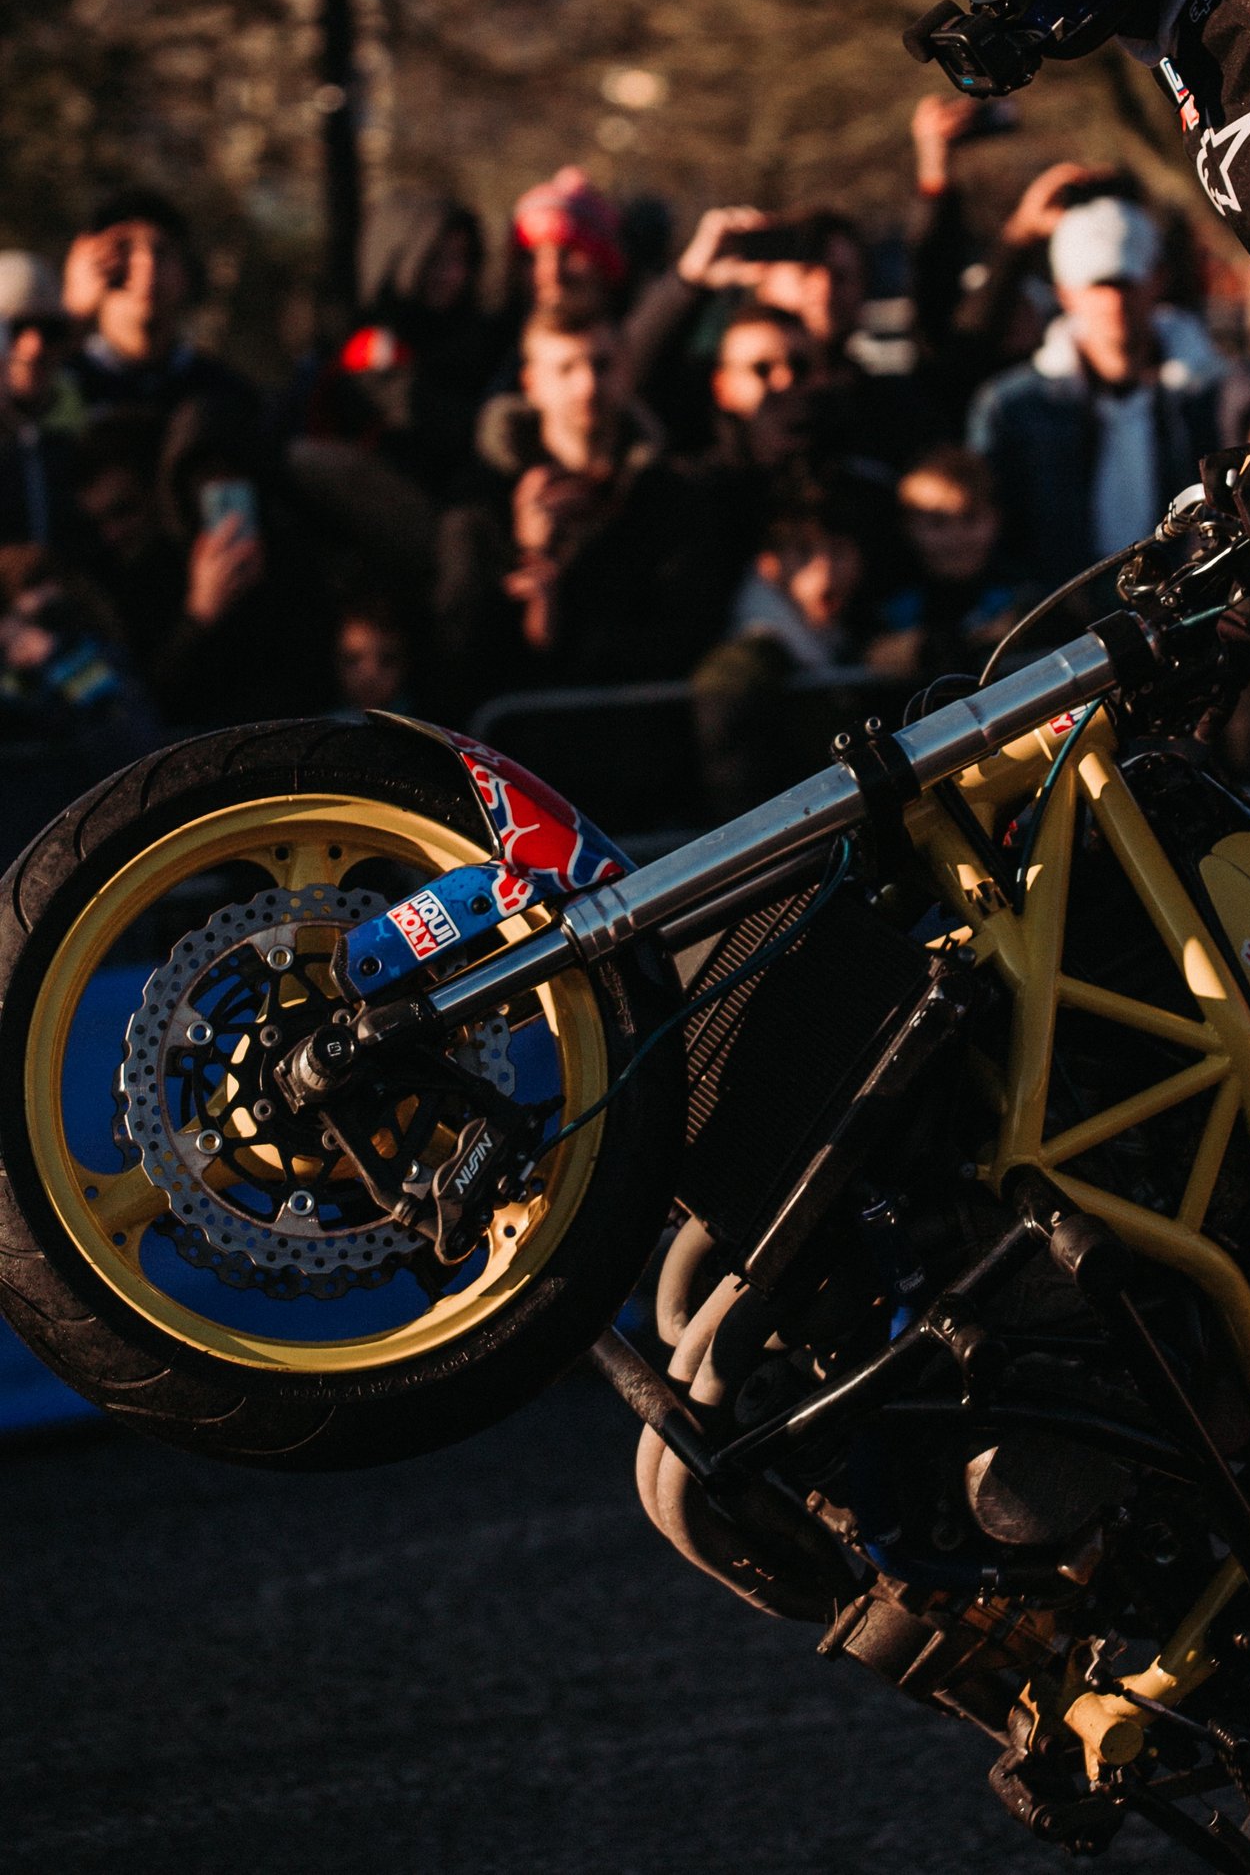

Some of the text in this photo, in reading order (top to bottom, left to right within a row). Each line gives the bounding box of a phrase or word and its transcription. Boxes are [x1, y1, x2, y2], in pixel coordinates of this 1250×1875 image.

[390, 903, 438, 952] MOLY
[410, 893, 456, 944] LIQUI
[454, 1131, 494, 1195] NISSIN
